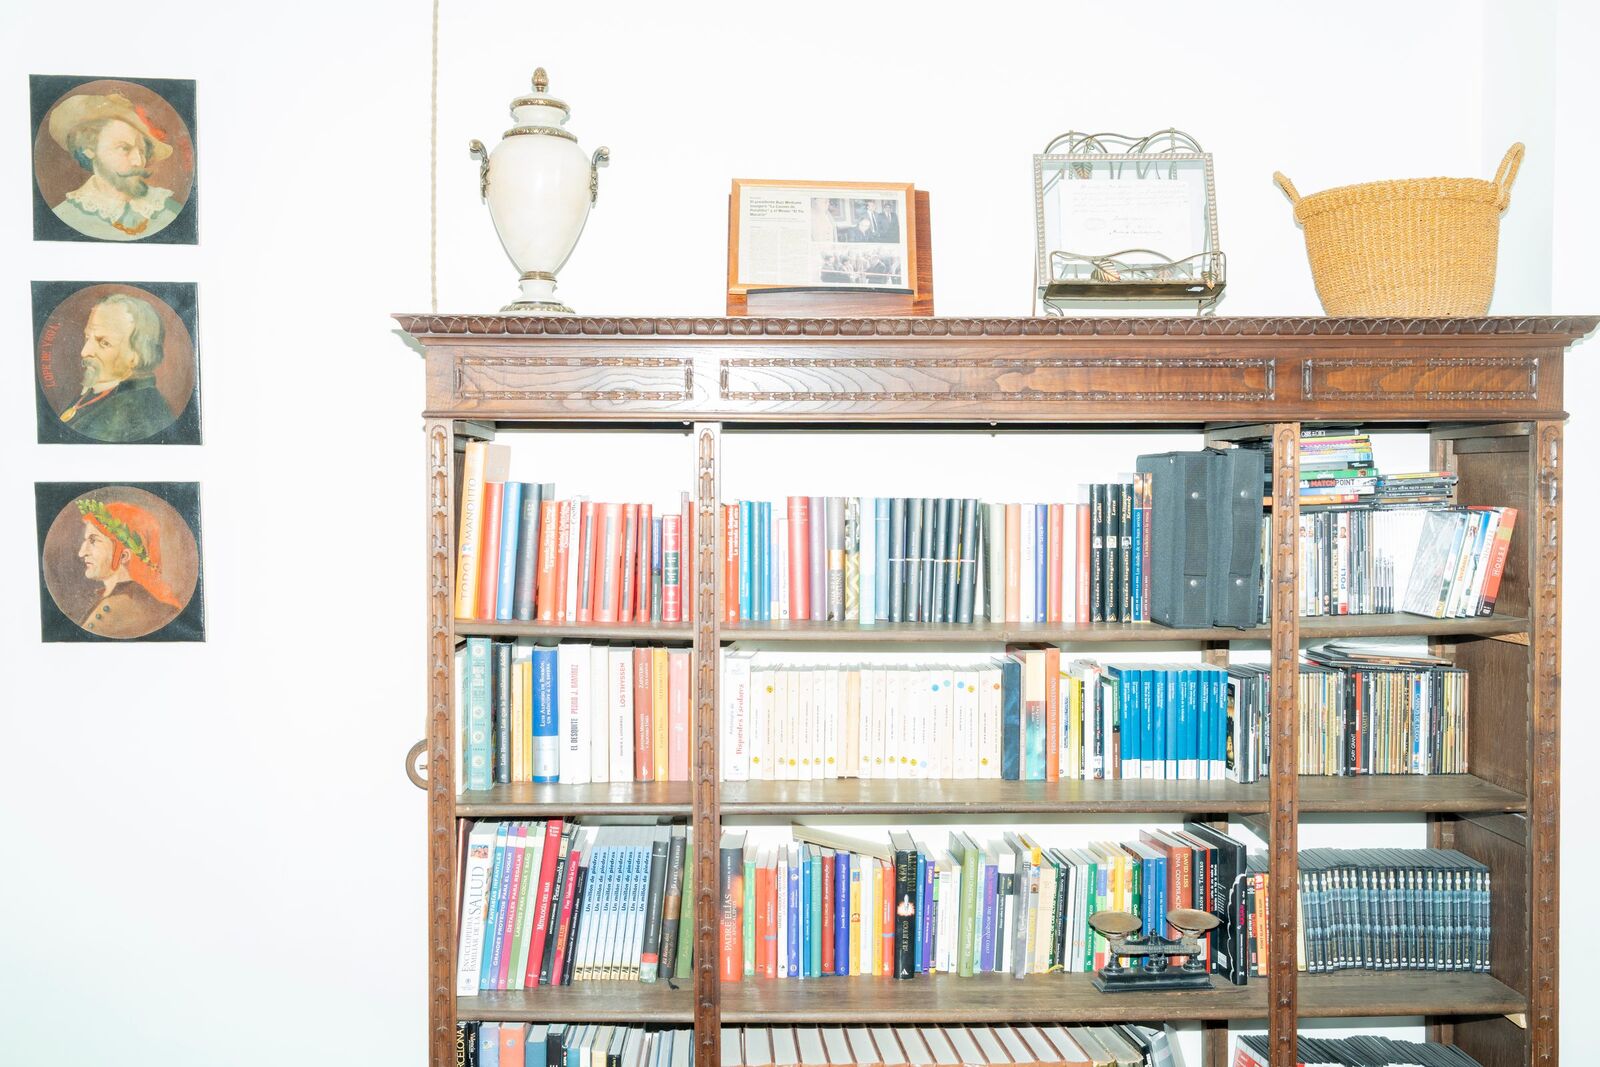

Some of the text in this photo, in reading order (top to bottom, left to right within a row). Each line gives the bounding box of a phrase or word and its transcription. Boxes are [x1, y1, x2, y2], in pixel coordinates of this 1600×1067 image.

[460, 563, 471, 600] TODO
[503, 875, 509, 883] EL
[513, 854, 522, 882] REGALAR
[585, 902, 591, 912] Un
[591, 852, 599, 875] piedras
[630, 901, 636, 911] Un
[636, 852, 644, 874] piedras
[639, 901, 645, 912] Un
[645, 852, 653, 874] piedras
[907, 853, 916, 892] FOLLETT
[470, 866, 484, 915] SALUD
[510, 883, 518, 899] PARA
[496, 901, 506, 936] PROYECTOS
[594, 901, 600, 912] Un
[603, 901, 609, 911] Un
[611, 901, 618, 911] Un
[620, 901, 627, 911] Un
[723, 894, 732, 919] ELÍAS
[493, 937, 502, 966] GRANDES
